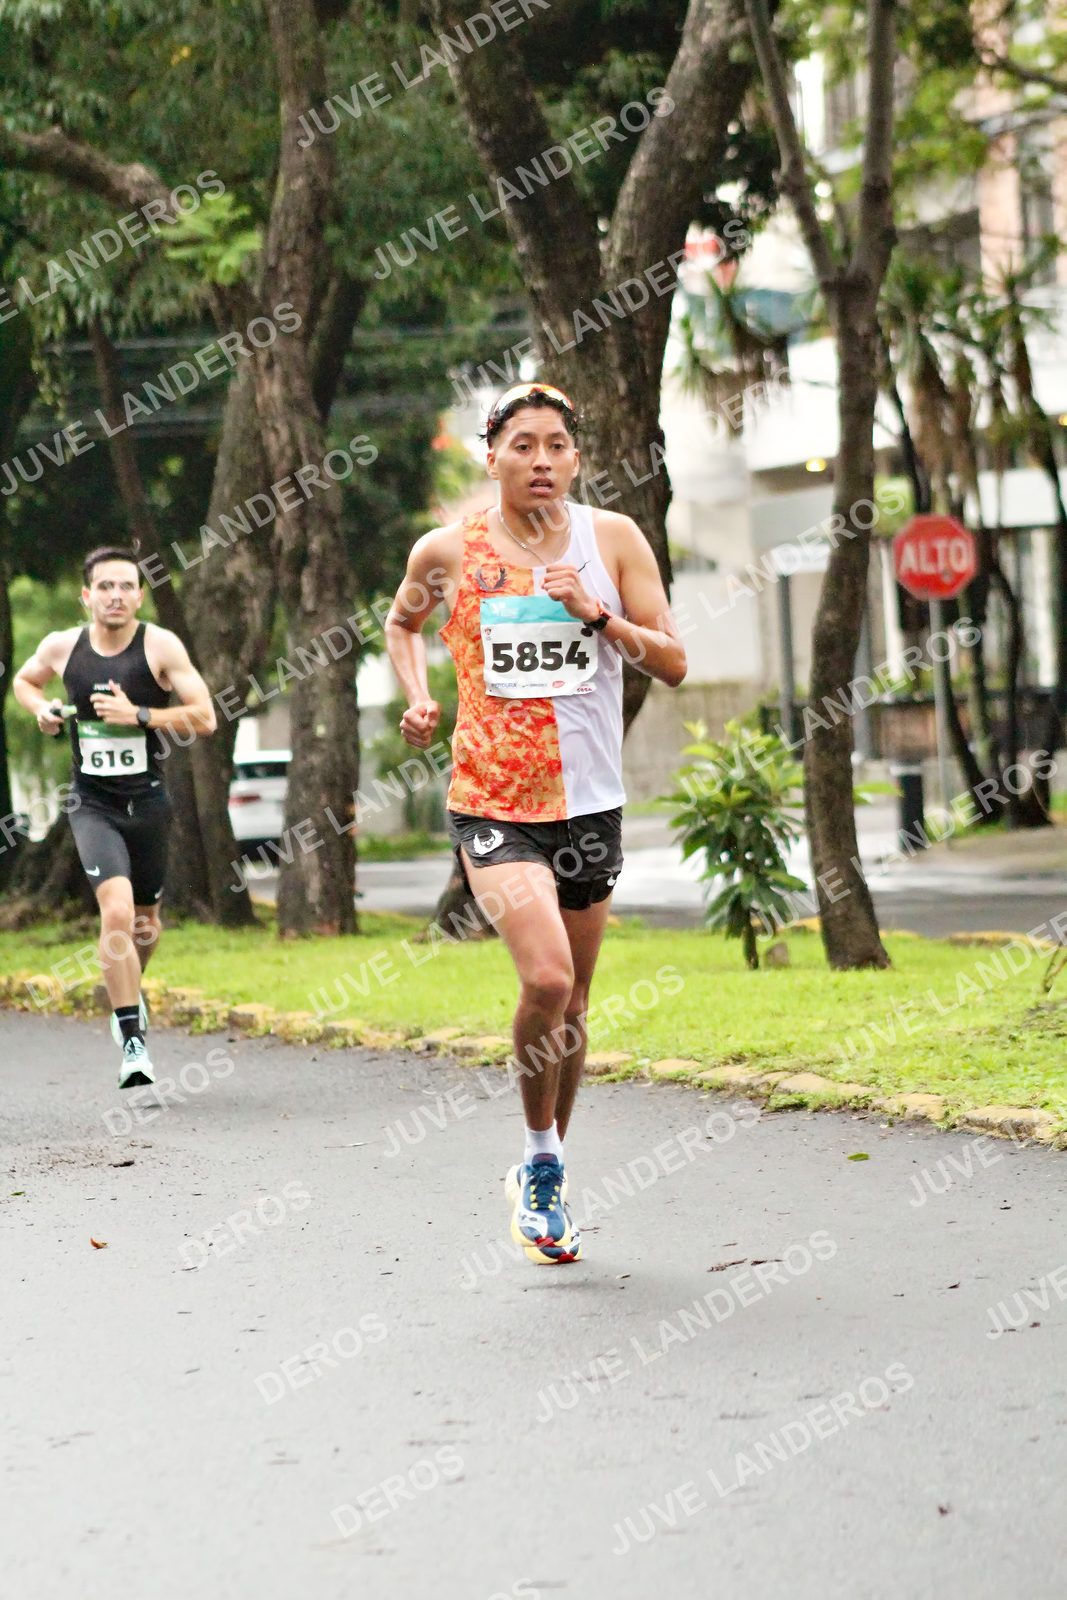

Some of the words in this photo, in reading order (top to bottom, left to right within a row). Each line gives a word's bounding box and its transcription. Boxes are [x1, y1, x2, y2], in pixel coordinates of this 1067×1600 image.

[901, 538, 969, 574] ALTO
[491, 640, 590, 674] 5854
[91, 749, 135, 769] 616
